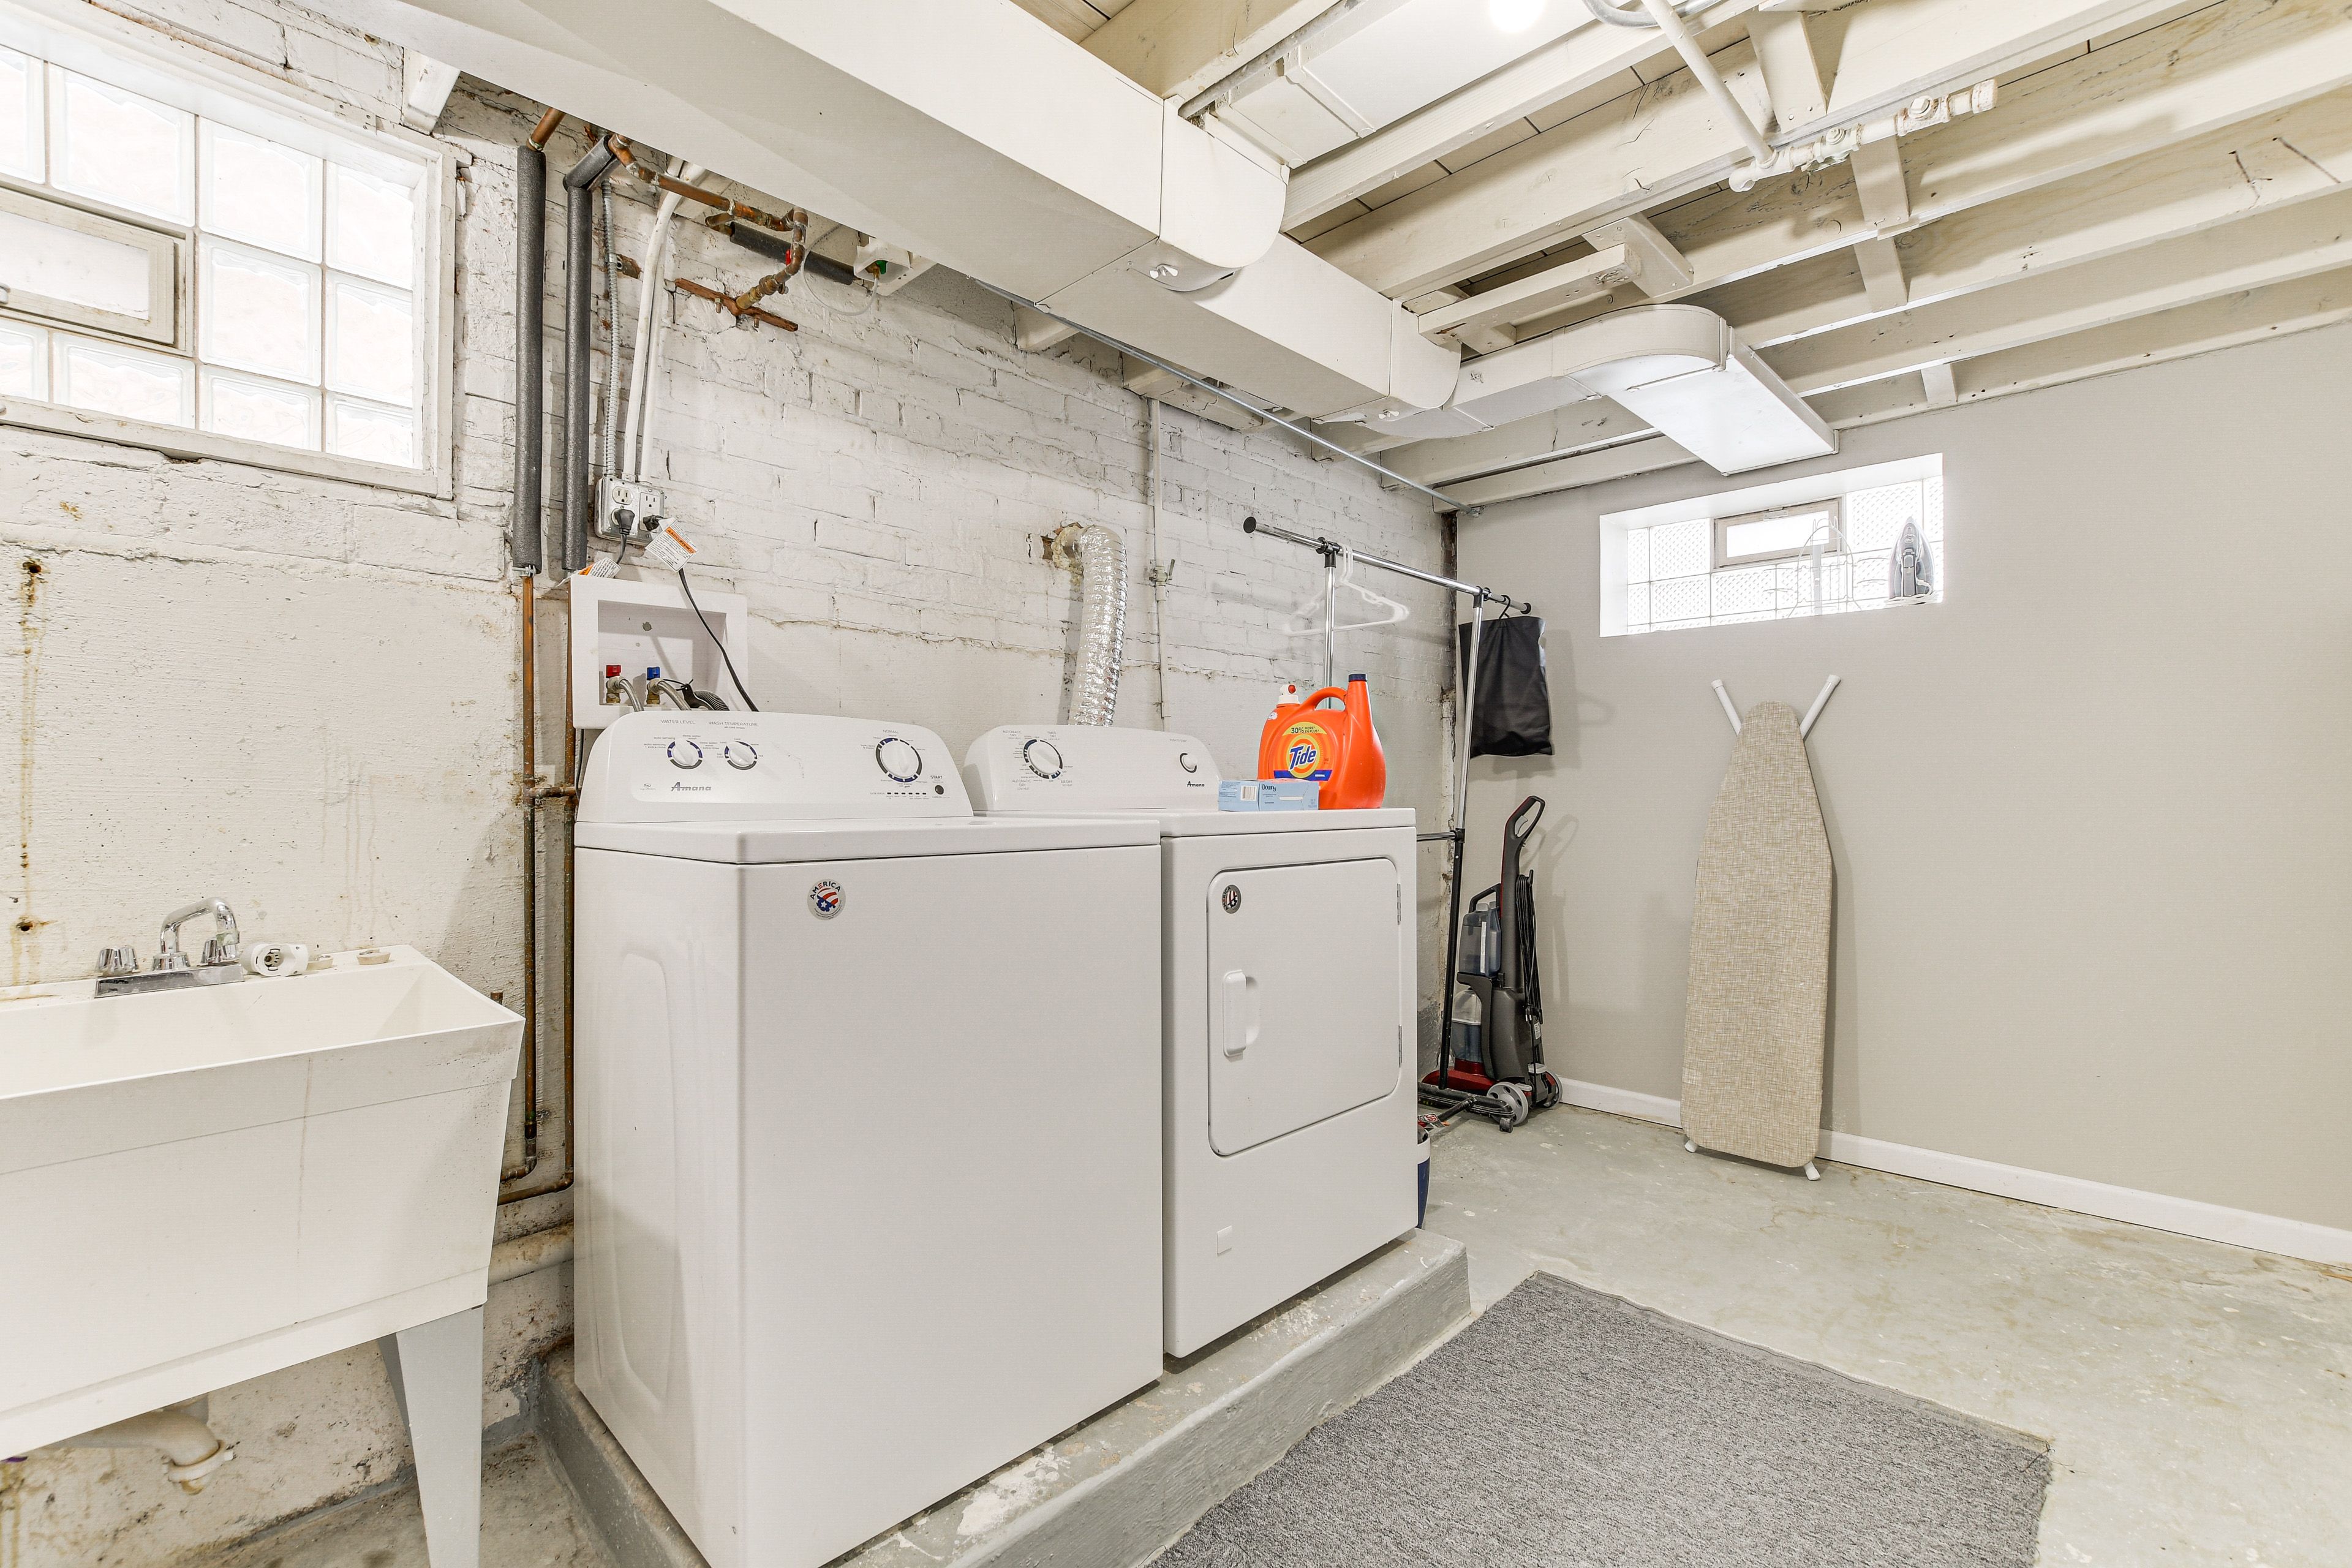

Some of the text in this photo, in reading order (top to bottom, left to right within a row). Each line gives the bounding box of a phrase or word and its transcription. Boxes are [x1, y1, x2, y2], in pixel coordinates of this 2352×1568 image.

[1289, 745, 1317, 770] Tide
[671, 782, 711, 791] Amana
[810, 881, 841, 900] AMERICA
